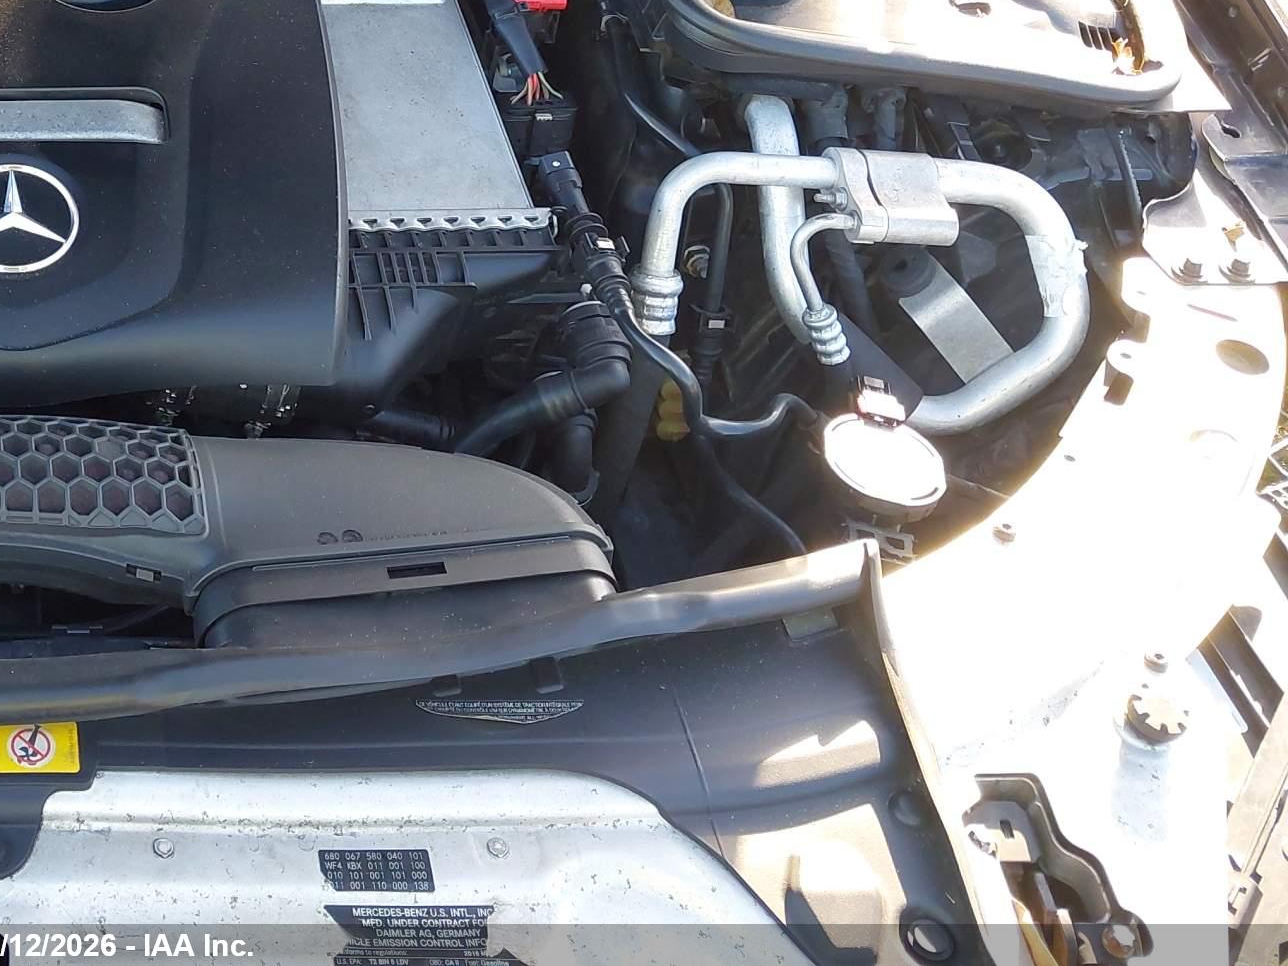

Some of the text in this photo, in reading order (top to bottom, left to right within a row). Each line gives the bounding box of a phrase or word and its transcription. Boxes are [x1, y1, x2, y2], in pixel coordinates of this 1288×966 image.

[324, 852, 423, 860] 680 067 580 040 101
[324, 862, 343, 870] WF4
[368, 862, 383, 870] 011
[388, 862, 404, 870] 001
[411, 862, 426, 870] 100
[327, 871, 427, 879] 010 101 001 101 000
[350, 882, 365, 890] 001
[372, 882, 387, 890] 110
[392, 882, 408, 890] 000
[414, 882, 429, 890] 138
[352, 907, 428, 917] MERCEDES-BENZ
[429, 908, 449, 917] U.S.
[361, 919, 385, 927] MFD.
[388, 919, 418, 928] UNDER
[420, 919, 471, 928] CONTRACT
[376, 929, 481, 939] DAIMLER AG, GERMANY
[372, 938, 418, 947] EMISSION
[419, 938, 463, 948] CONTROL
